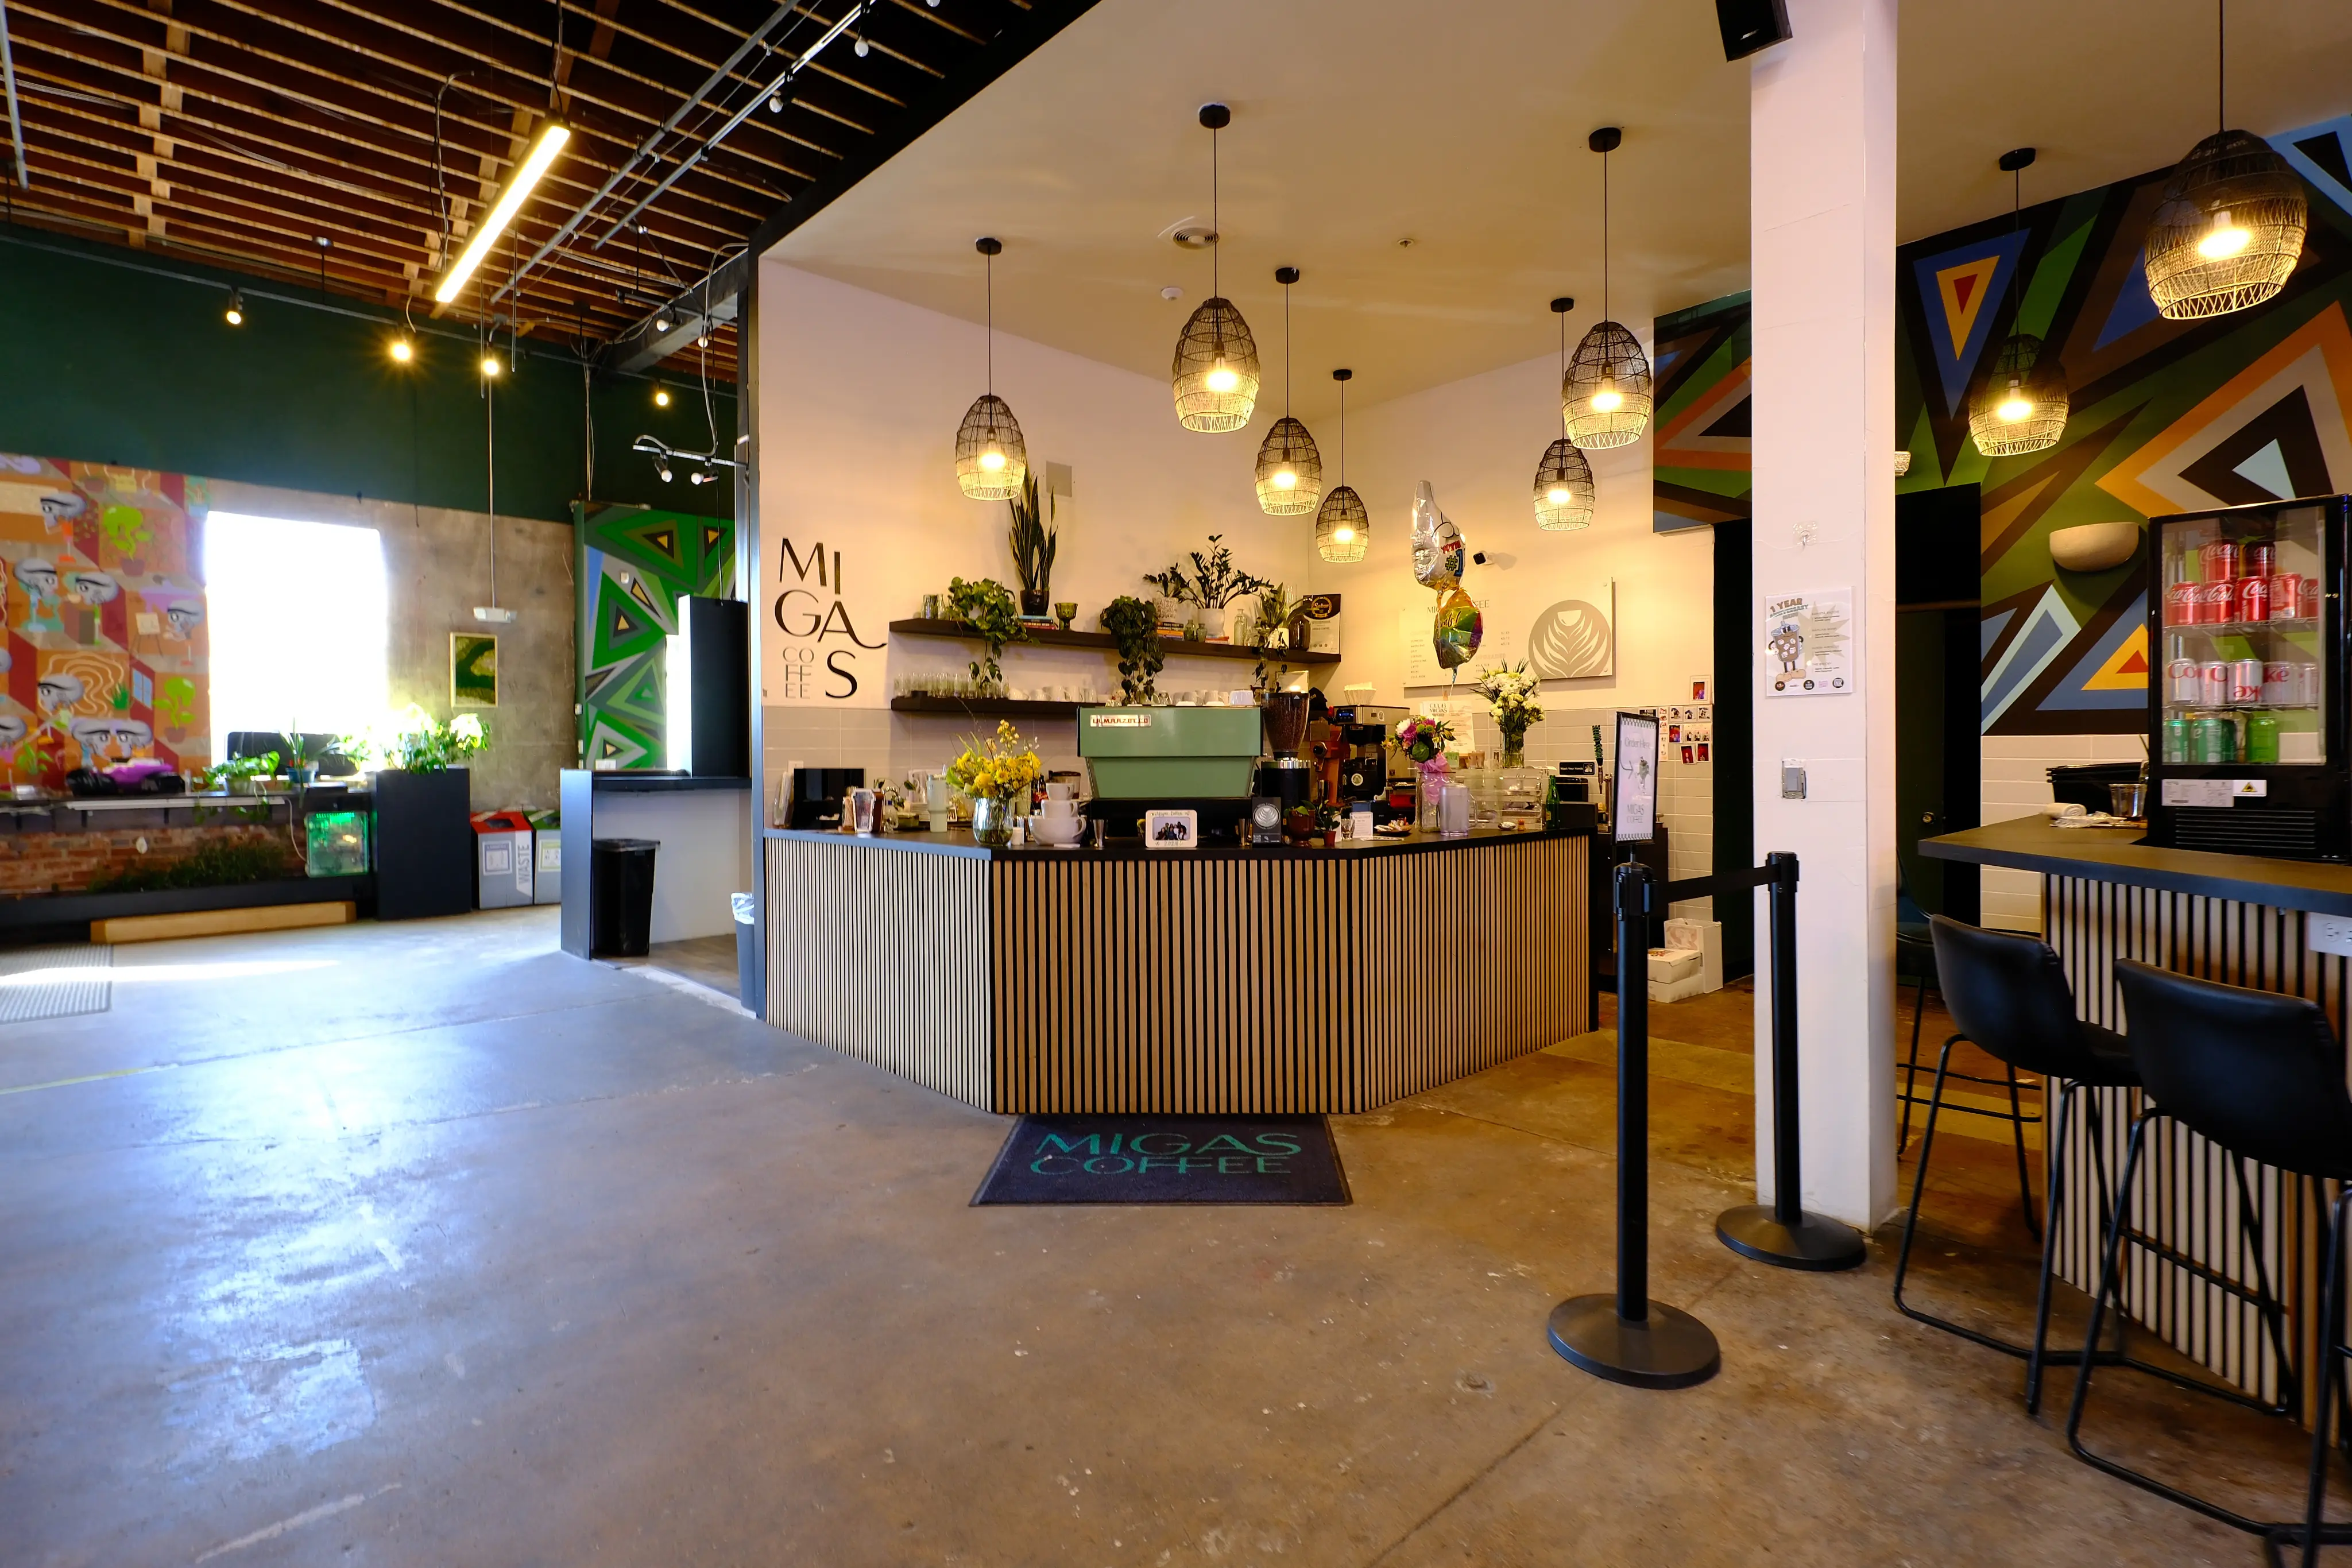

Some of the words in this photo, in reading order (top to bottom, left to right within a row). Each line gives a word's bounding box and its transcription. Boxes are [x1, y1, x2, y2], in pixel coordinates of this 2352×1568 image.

[1777, 598, 1802, 610] YEAR
[1624, 736, 1639, 748] Order
[1627, 804, 1645, 815] MIGAS
[1626, 815, 1643, 824] COFFEE
[518, 844, 529, 884] WASTE
[1035, 1132, 1301, 1156] MIGAS
[1030, 1156, 1291, 1176] COFFEE
